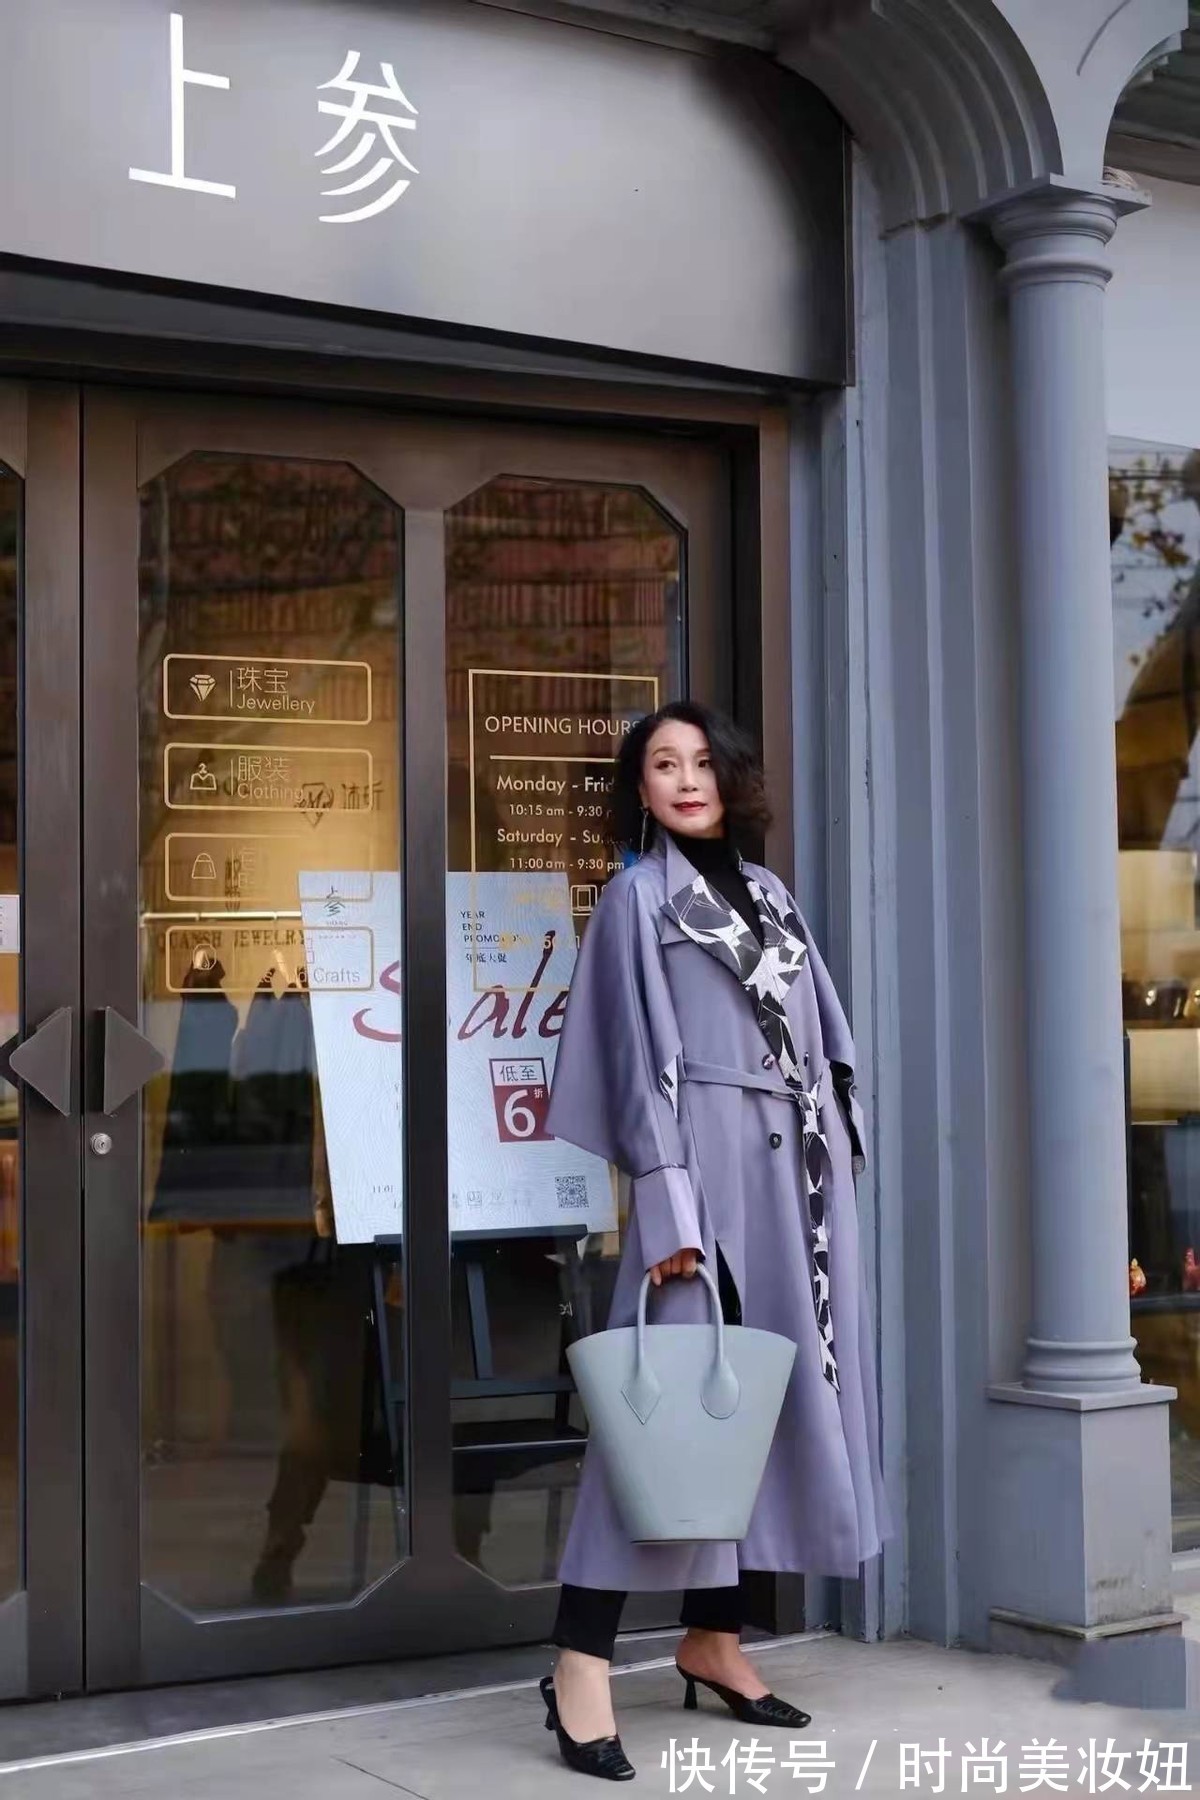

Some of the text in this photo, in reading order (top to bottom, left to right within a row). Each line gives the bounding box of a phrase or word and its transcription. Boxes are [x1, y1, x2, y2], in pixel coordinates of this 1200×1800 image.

[129, 13, 420, 223] 上参
[236, 666, 289, 694] 珠宝
[236, 693, 316, 715] Jewellery
[485, 716, 572, 735] OPENING
[237, 755, 292, 783] 服装
[237, 783, 304, 802] Clothing
[496, 775, 566, 796] Monday
[509, 803, 543, 816] 10:15
[547, 807, 565, 817] am
[577, 805, 603, 818] 9:30
[497, 828, 563, 848] Saturday
[509, 857, 544, 870] 11:00
[546, 861, 566, 870] am
[578, 859, 604, 871] 9:30
[607, 861, 625, 873] pm
[313, 967, 361, 984] Crafts
[500, 1064, 538, 1083] 低至
